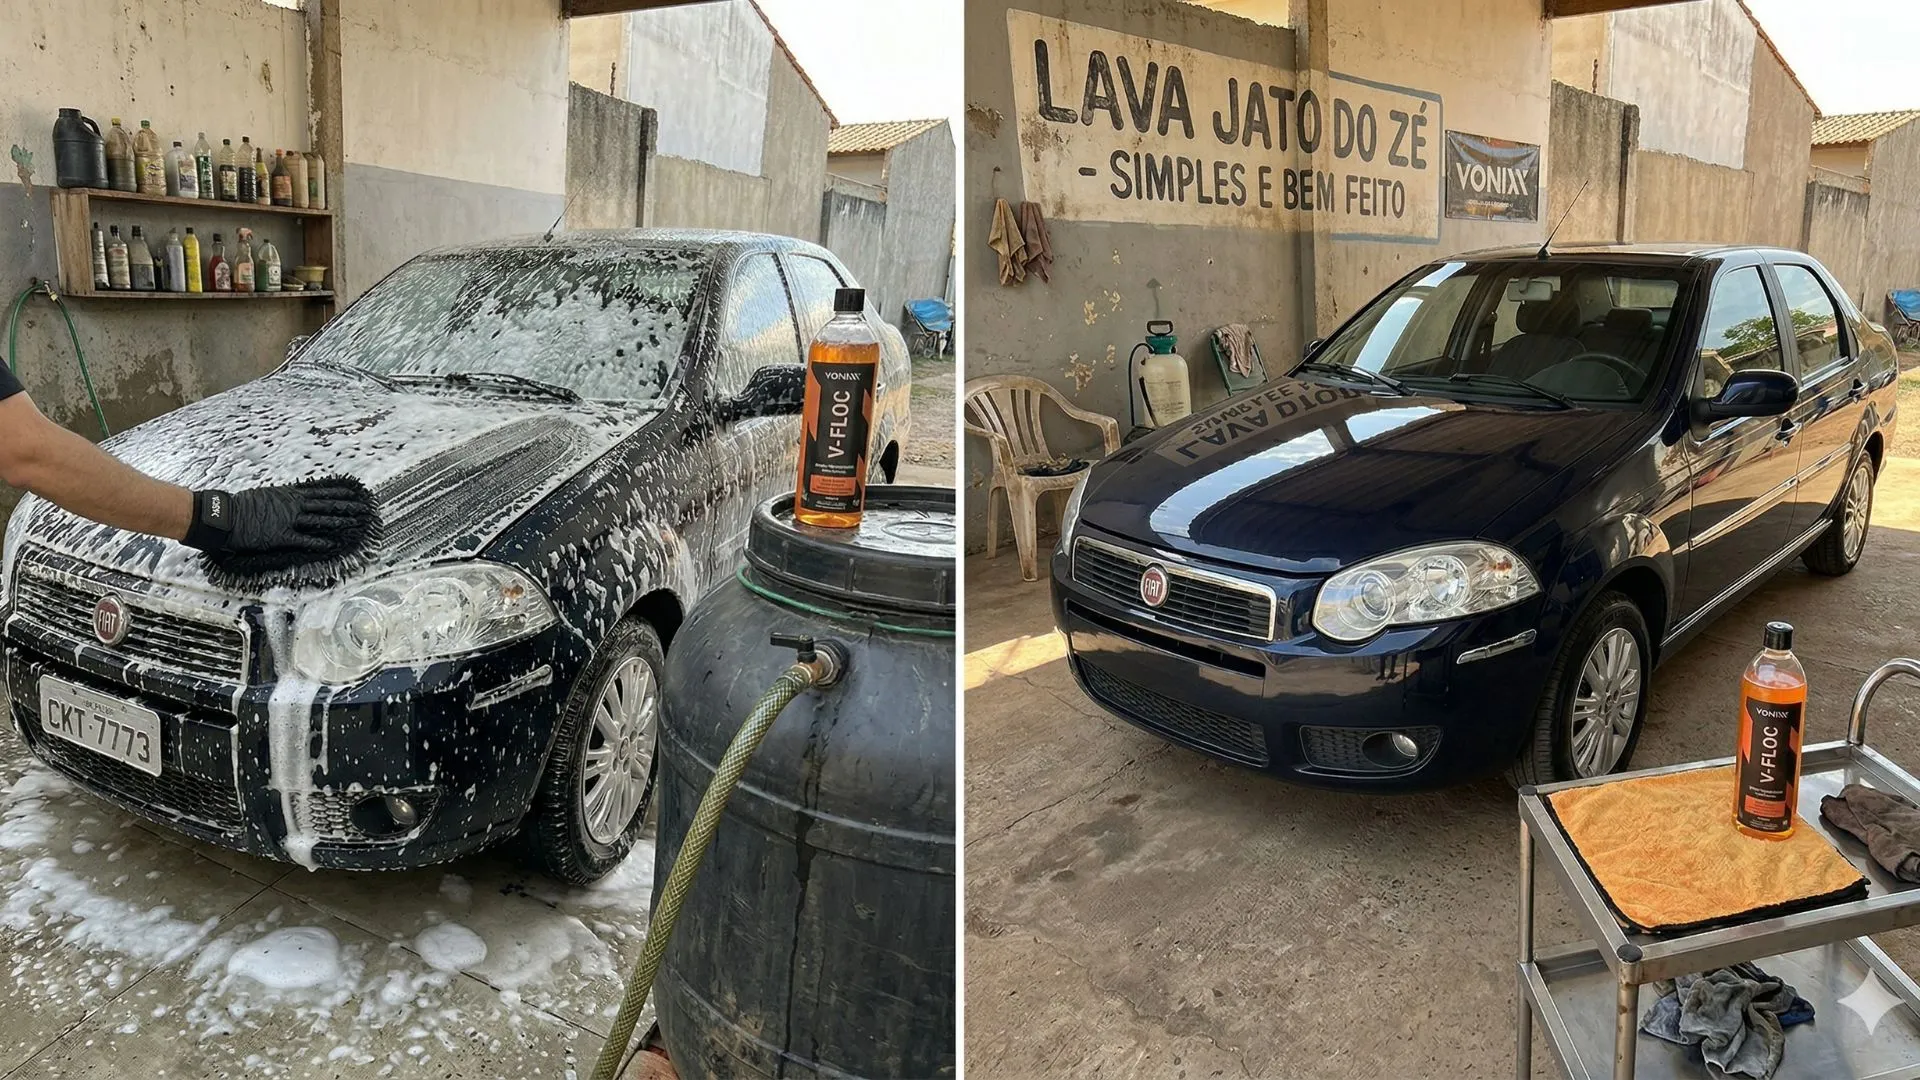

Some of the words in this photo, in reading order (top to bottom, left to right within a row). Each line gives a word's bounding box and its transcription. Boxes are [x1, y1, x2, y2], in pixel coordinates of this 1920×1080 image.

[1034, 38, 1194, 140] LAVA
[1212, 78, 1322, 153] JATO
[1333, 98, 1377, 163] DO
[1388, 102, 1428, 169] ZÉ
[1109, 149, 1247, 206] SIMPLES
[1259, 166, 1273, 208] E
[1284, 168, 1335, 212] BEM
[1345, 175, 1405, 218] FEITO
[827, 390, 851, 459] V-FLOC
[1144, 578, 1161, 597] FIAT
[98, 609, 117, 633] FIAT
[1760, 726, 1779, 783] V-FLOC
